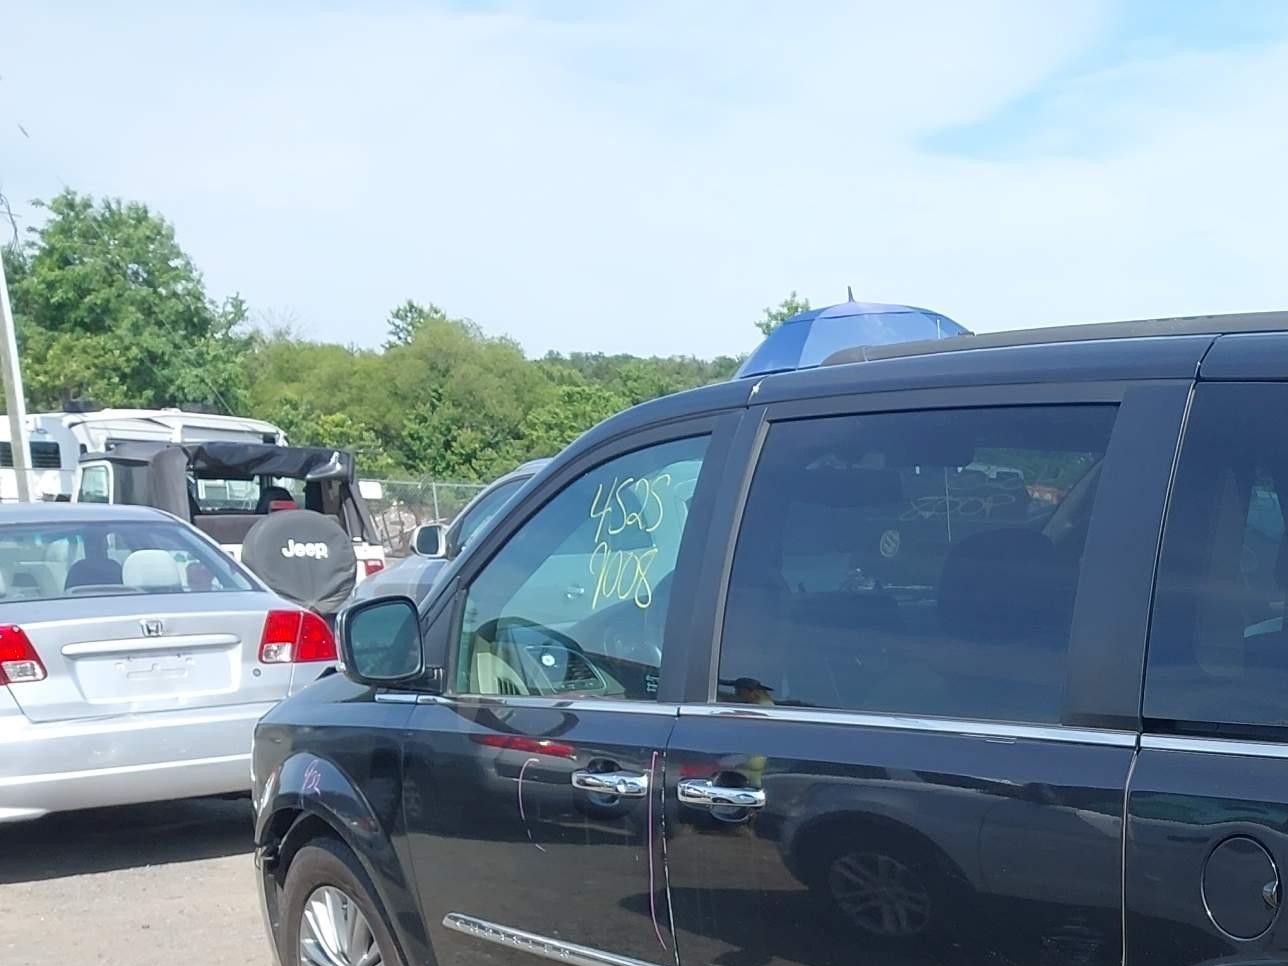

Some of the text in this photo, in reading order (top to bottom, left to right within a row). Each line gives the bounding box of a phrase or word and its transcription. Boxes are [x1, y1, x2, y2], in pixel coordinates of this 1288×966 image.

[590, 473, 671, 543] 4525
[281, 539, 329, 560] Jeep
[589, 541, 659, 610] 9008
